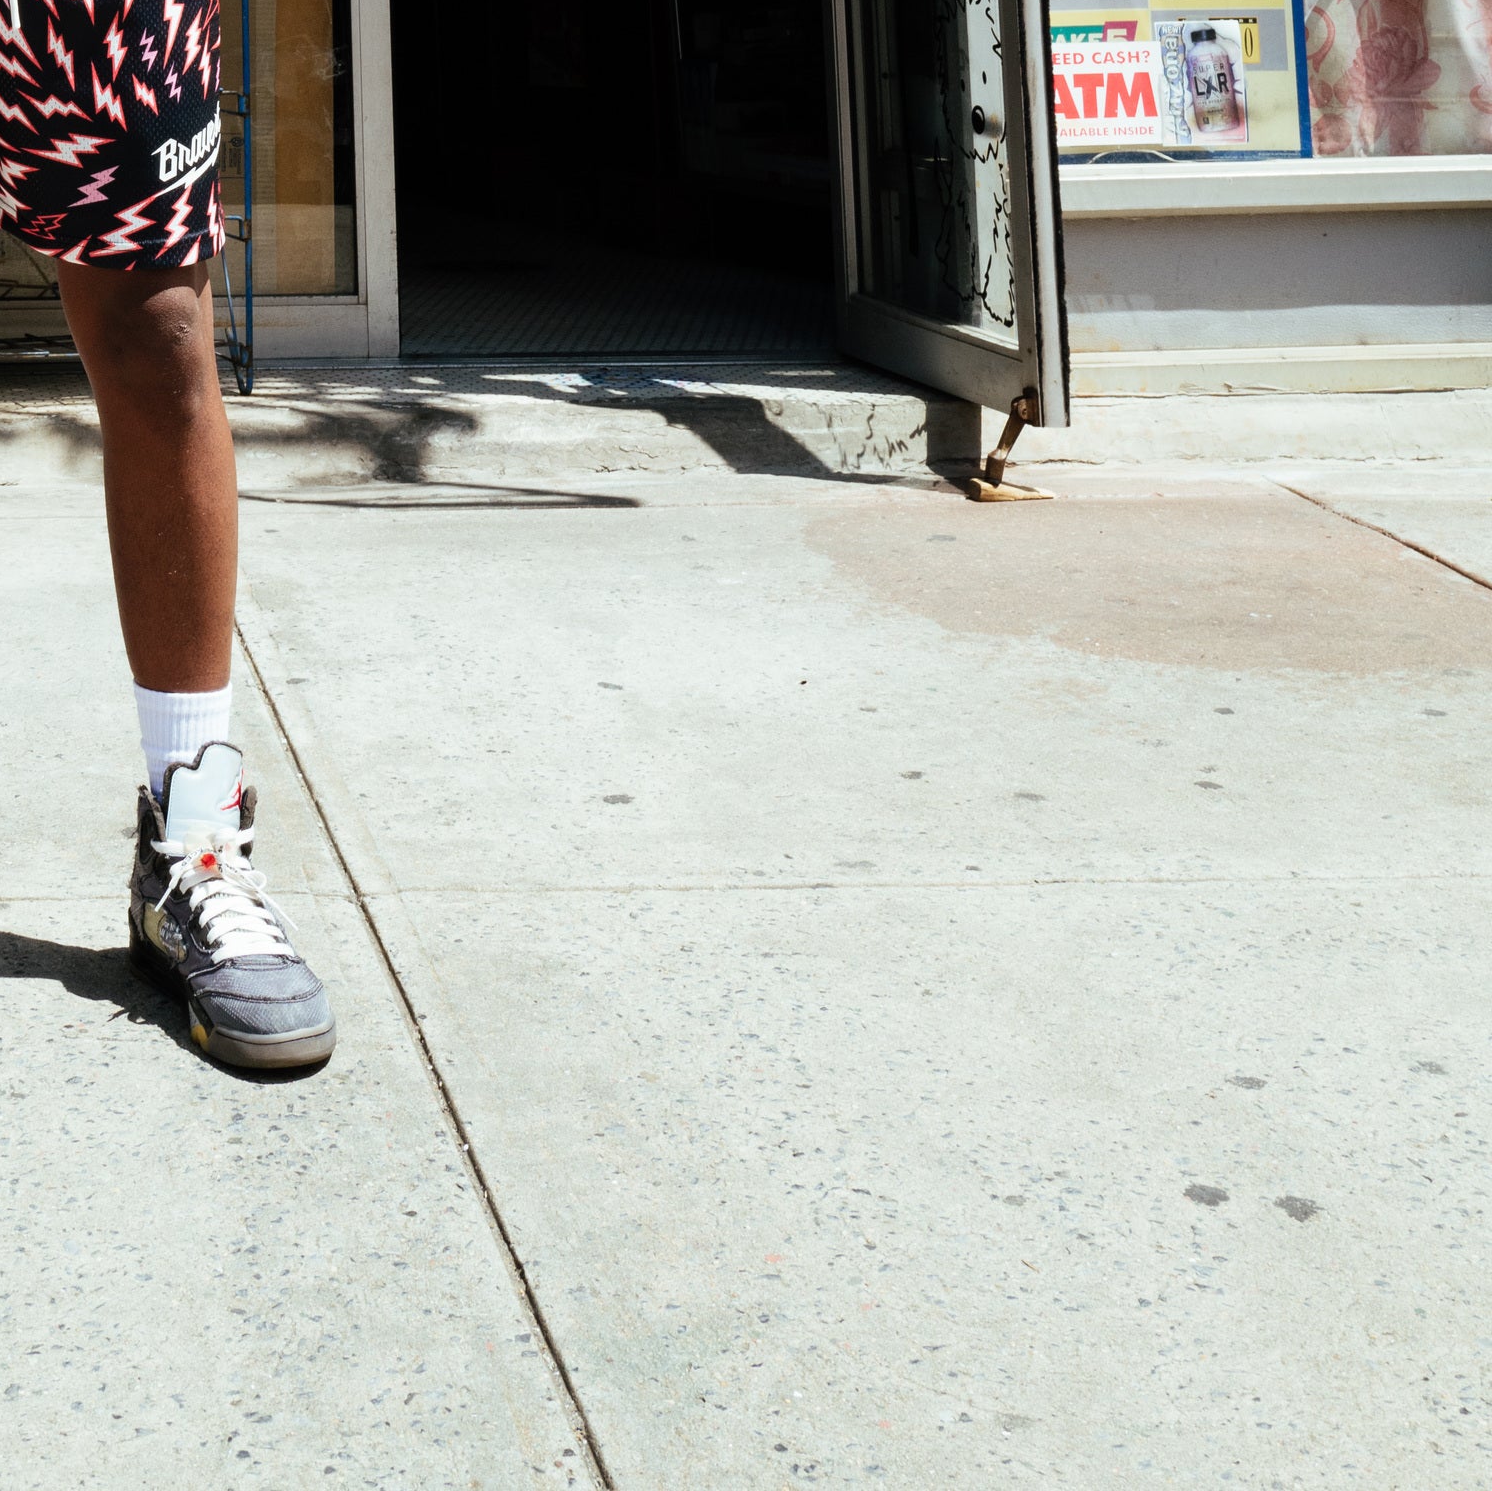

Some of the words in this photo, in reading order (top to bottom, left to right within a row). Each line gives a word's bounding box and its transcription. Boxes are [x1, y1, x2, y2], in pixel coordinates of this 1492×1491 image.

[1053, 52, 1084, 64] EED
[1193, 62, 1225, 71] SUPER
[1193, 74, 1230, 96] LXR
[1053, 72, 1158, 120] ATM
[1060, 126, 1108, 137] AILABLE
[1113, 126, 1155, 136] INSIDE
